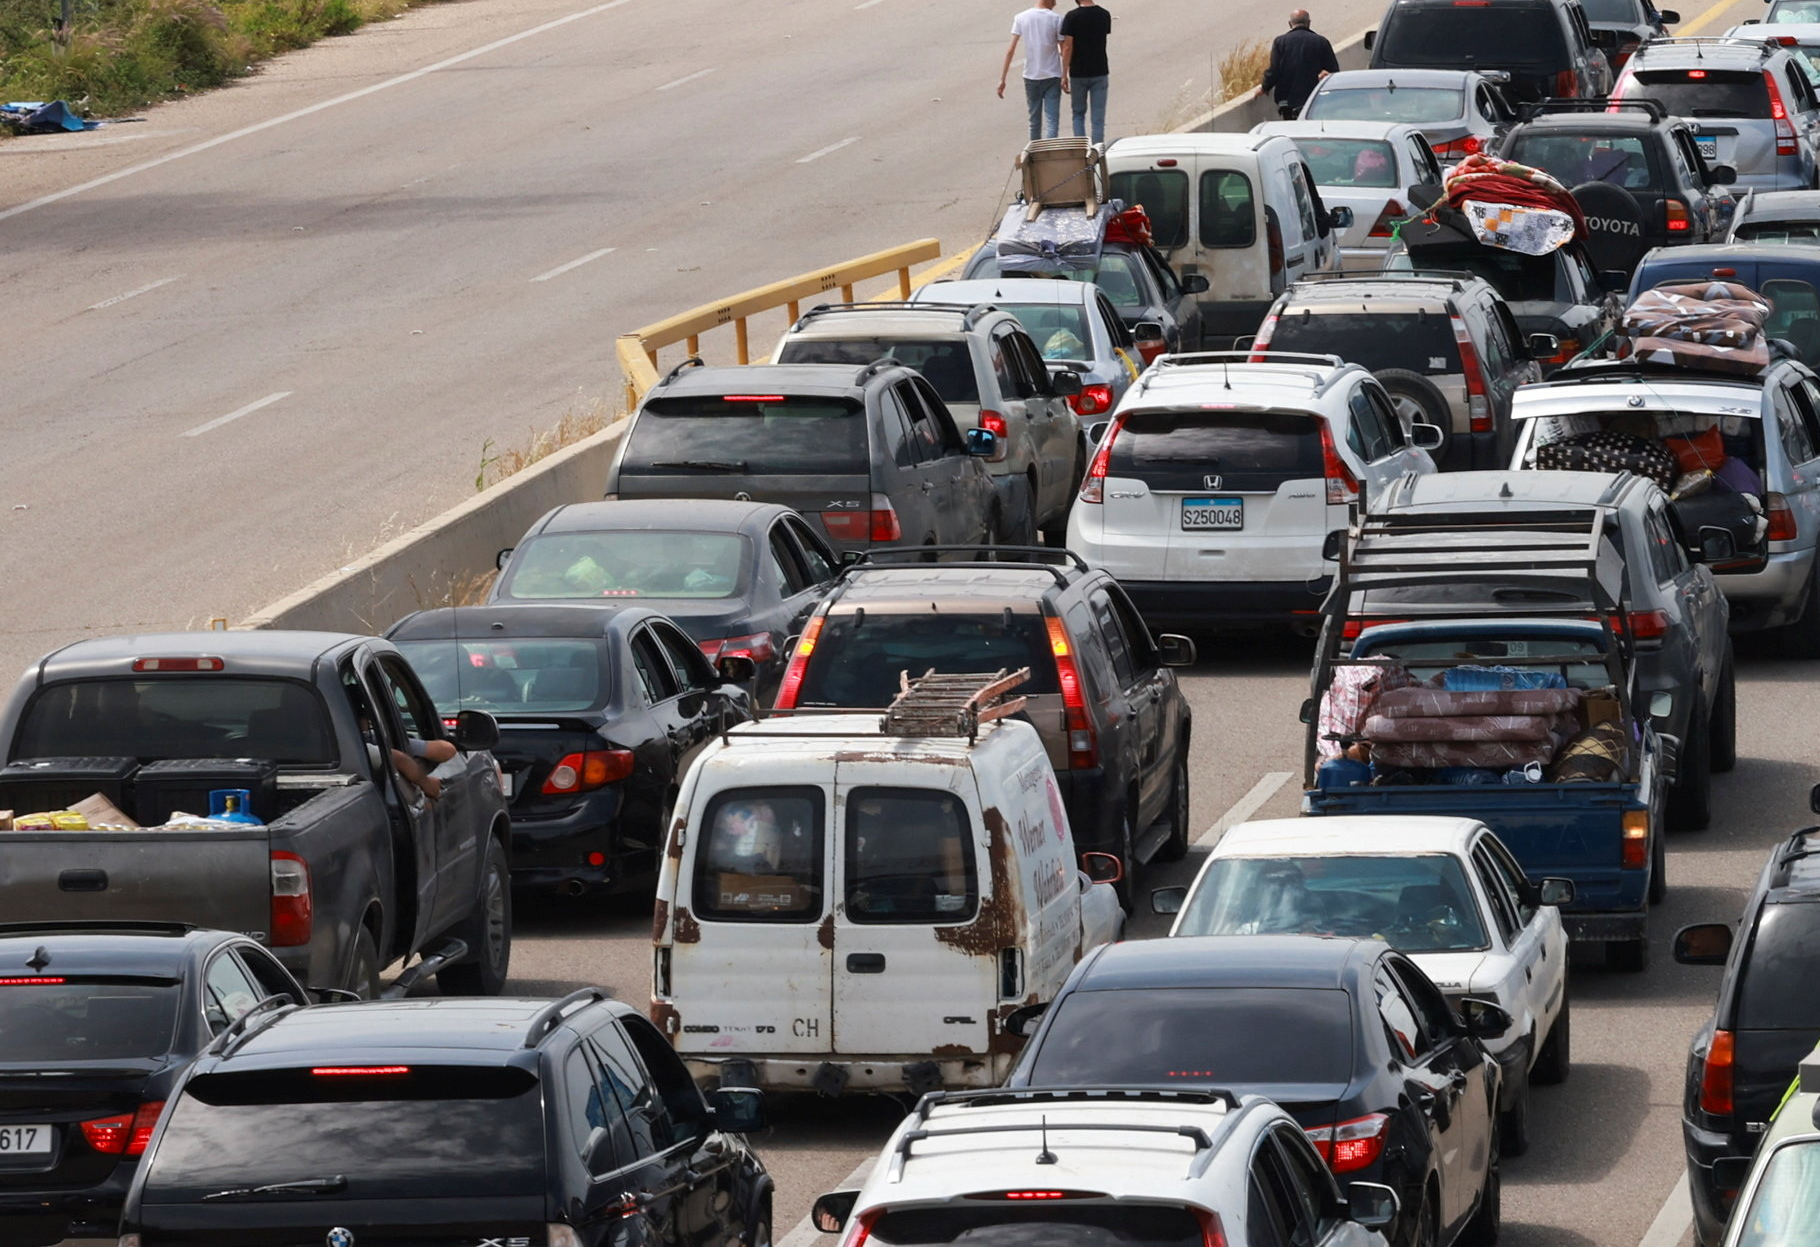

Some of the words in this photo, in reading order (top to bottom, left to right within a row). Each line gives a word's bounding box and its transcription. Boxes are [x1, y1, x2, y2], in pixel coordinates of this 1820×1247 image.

[827, 499, 861, 509] X5
[1183, 509, 1242, 526] S250048
[792, 1018, 819, 1038] CH
